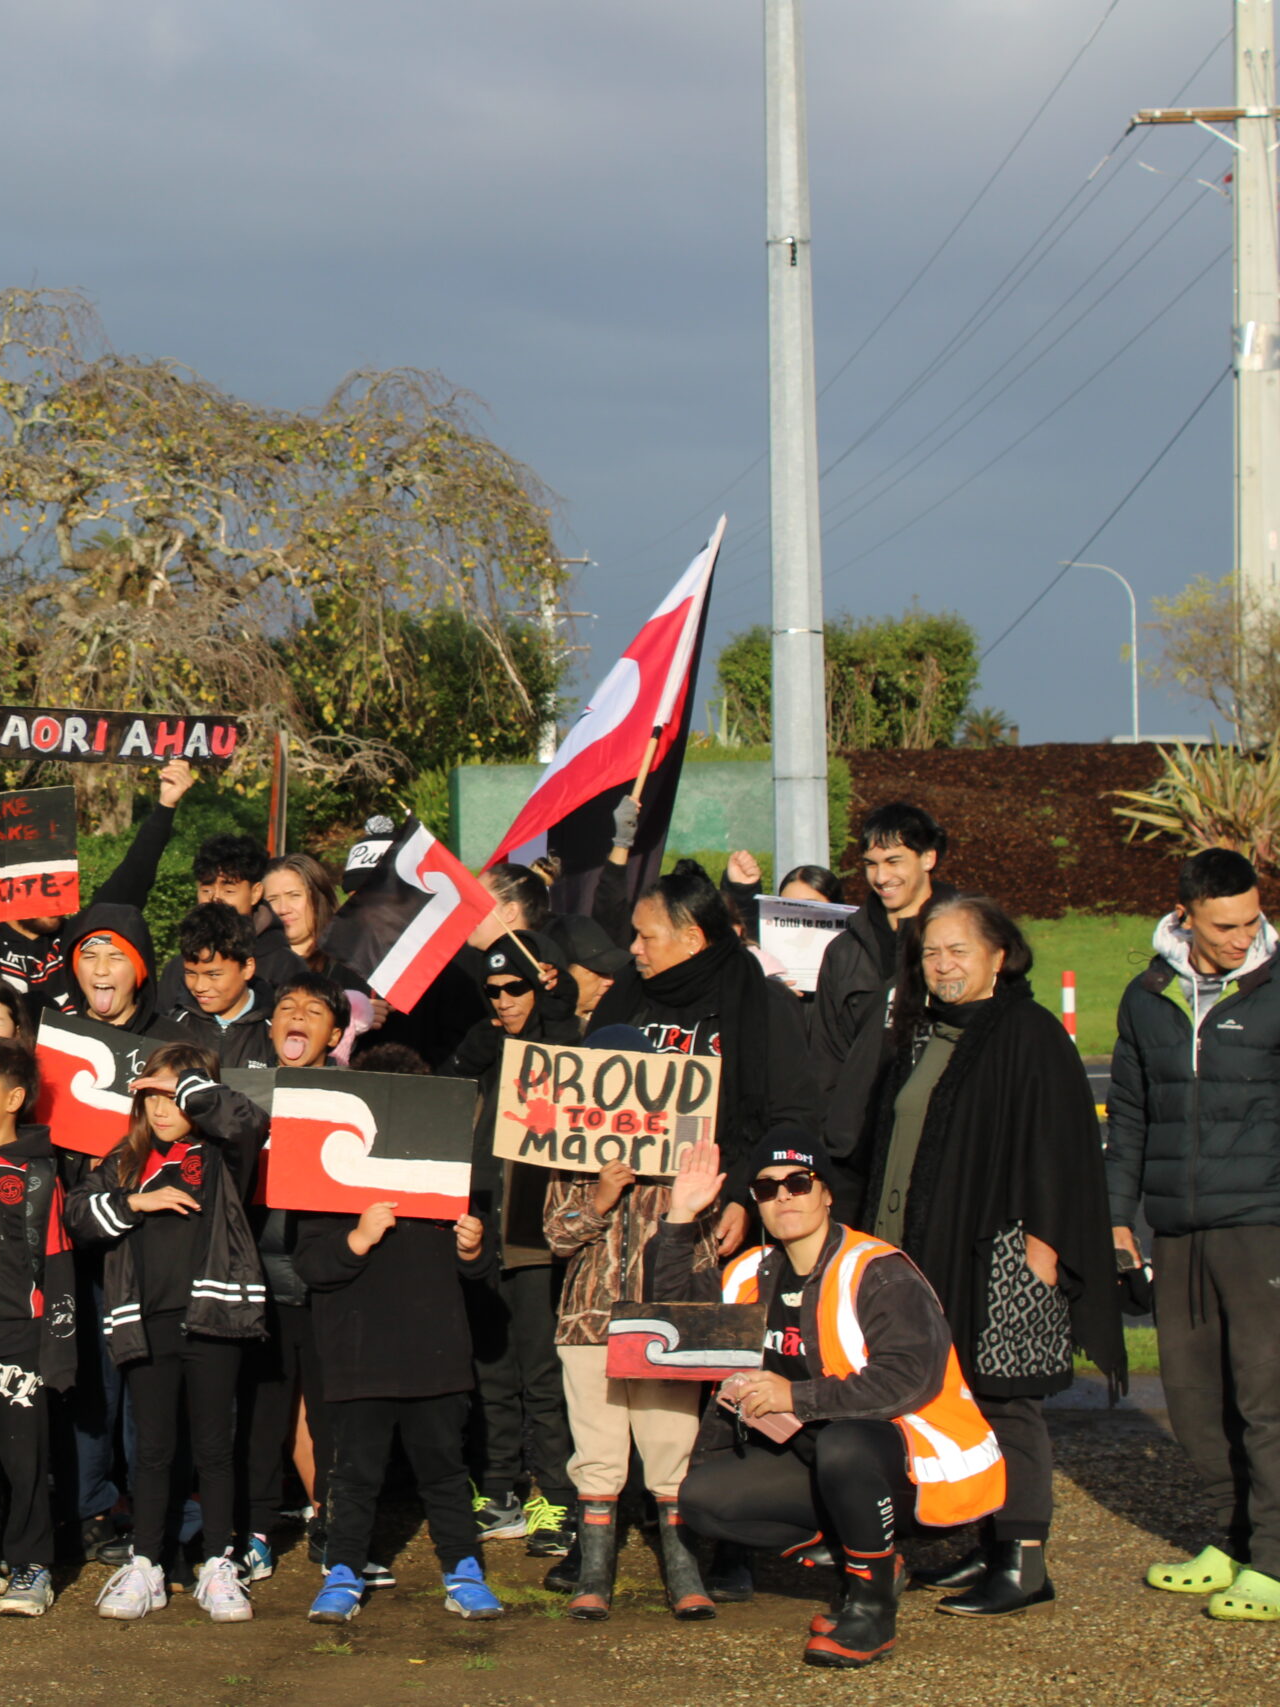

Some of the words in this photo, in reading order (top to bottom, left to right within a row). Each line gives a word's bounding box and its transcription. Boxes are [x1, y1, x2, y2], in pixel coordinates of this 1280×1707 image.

[119, 719, 237, 760] AHAU
[802, 917, 813, 928] te
[815, 919, 833, 929] reo
[518, 1044, 712, 1114] PROUD
[565, 1107, 604, 1127] TO
